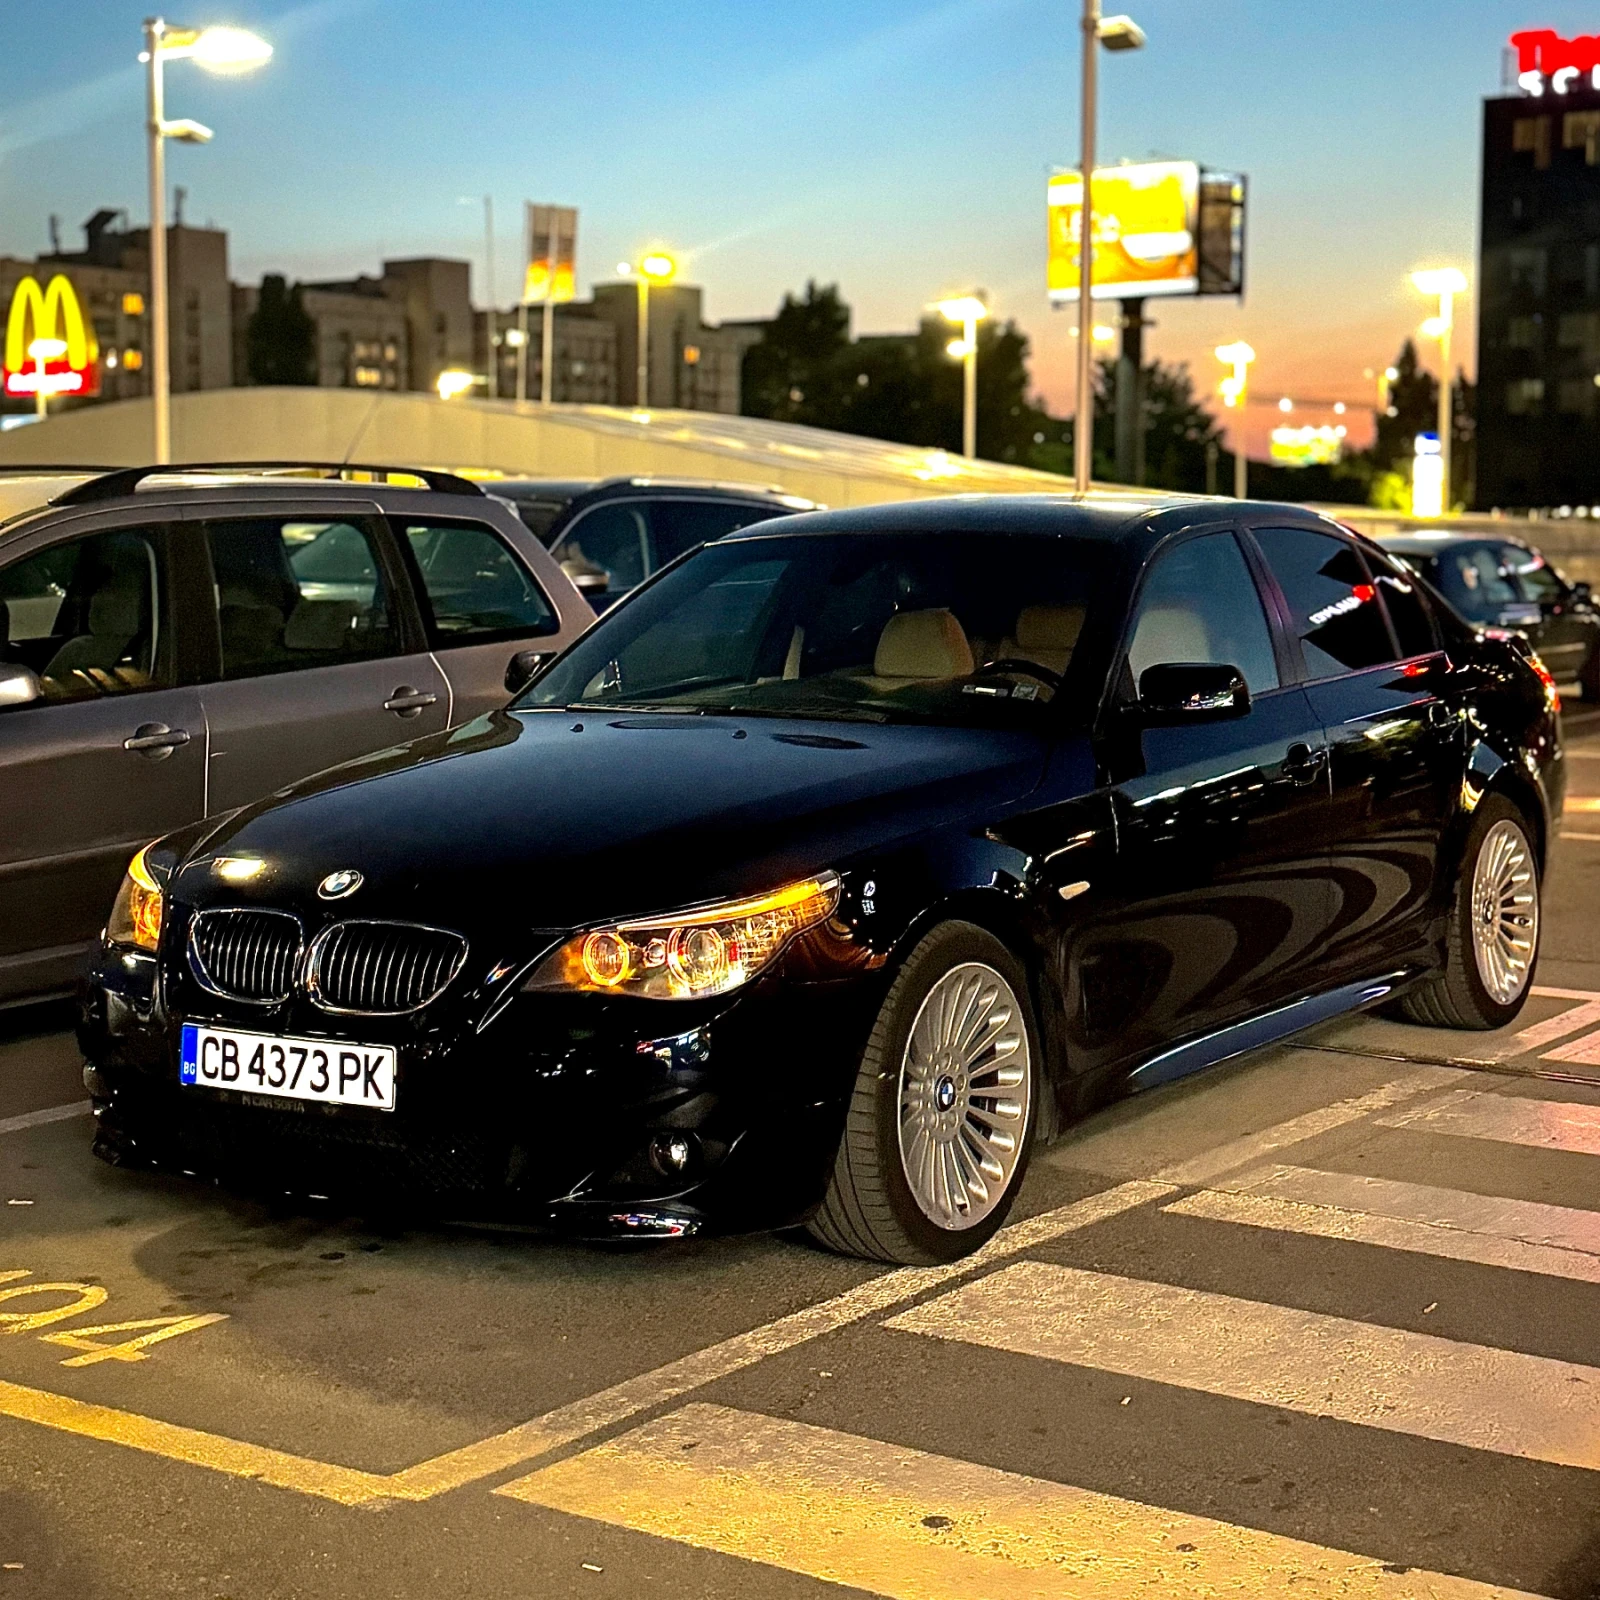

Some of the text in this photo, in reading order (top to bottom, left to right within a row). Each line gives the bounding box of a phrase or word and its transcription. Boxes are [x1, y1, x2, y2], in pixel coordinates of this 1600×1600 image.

[183, 1062, 195, 1076] BG
[202, 1036, 385, 1101] CB 4373 PK
